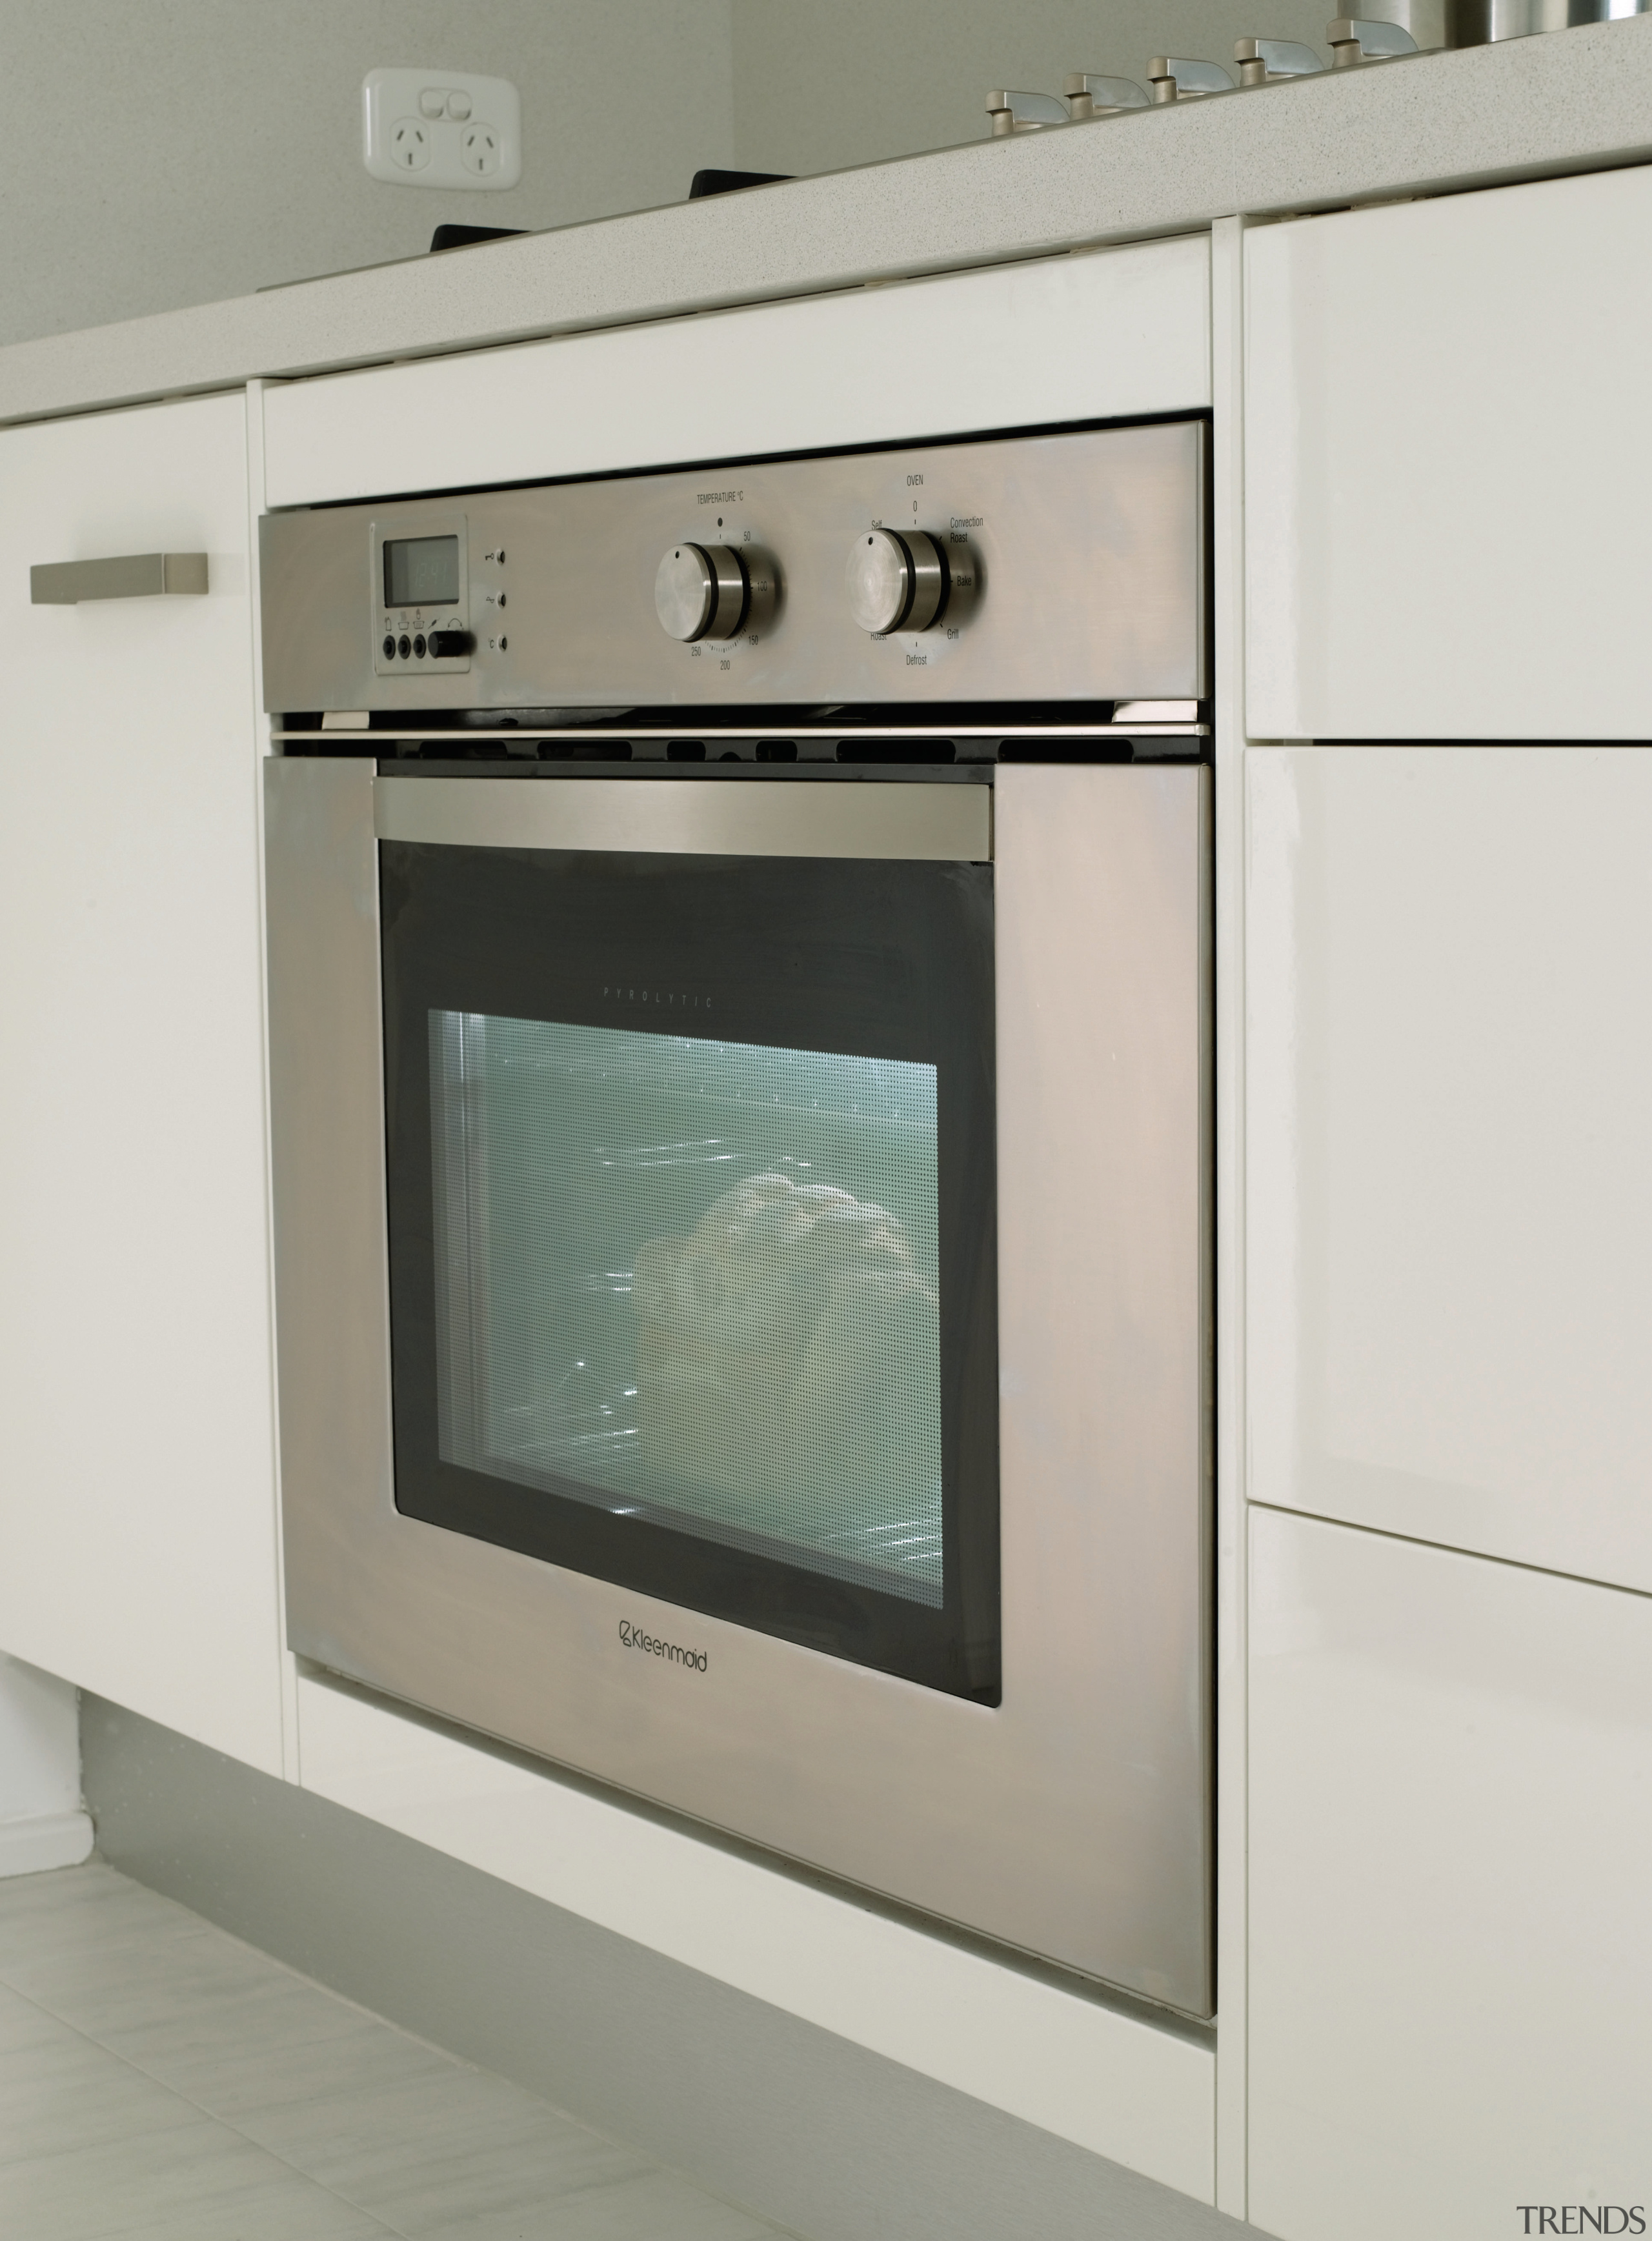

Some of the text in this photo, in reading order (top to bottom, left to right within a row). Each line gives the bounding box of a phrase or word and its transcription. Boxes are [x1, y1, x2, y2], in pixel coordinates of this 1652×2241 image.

[907, 475, 923, 487] OVEN
[697, 491, 736, 505] TEMPERATURE
[950, 516, 983, 528] Convection
[743, 531, 750, 541] 50
[950, 532, 967, 543] Roast
[957, 575, 972, 586] Bake
[757, 581, 767, 592] 100
[947, 628, 959, 639] Grill
[749, 636, 758, 645] 150
[691, 647, 701, 656] 250
[720, 660, 730, 670] 200
[906, 654, 927, 665] Defrost
[603, 987, 712, 1008] PYROLYTIC
[632, 1625, 707, 1673] Kleenmaid
